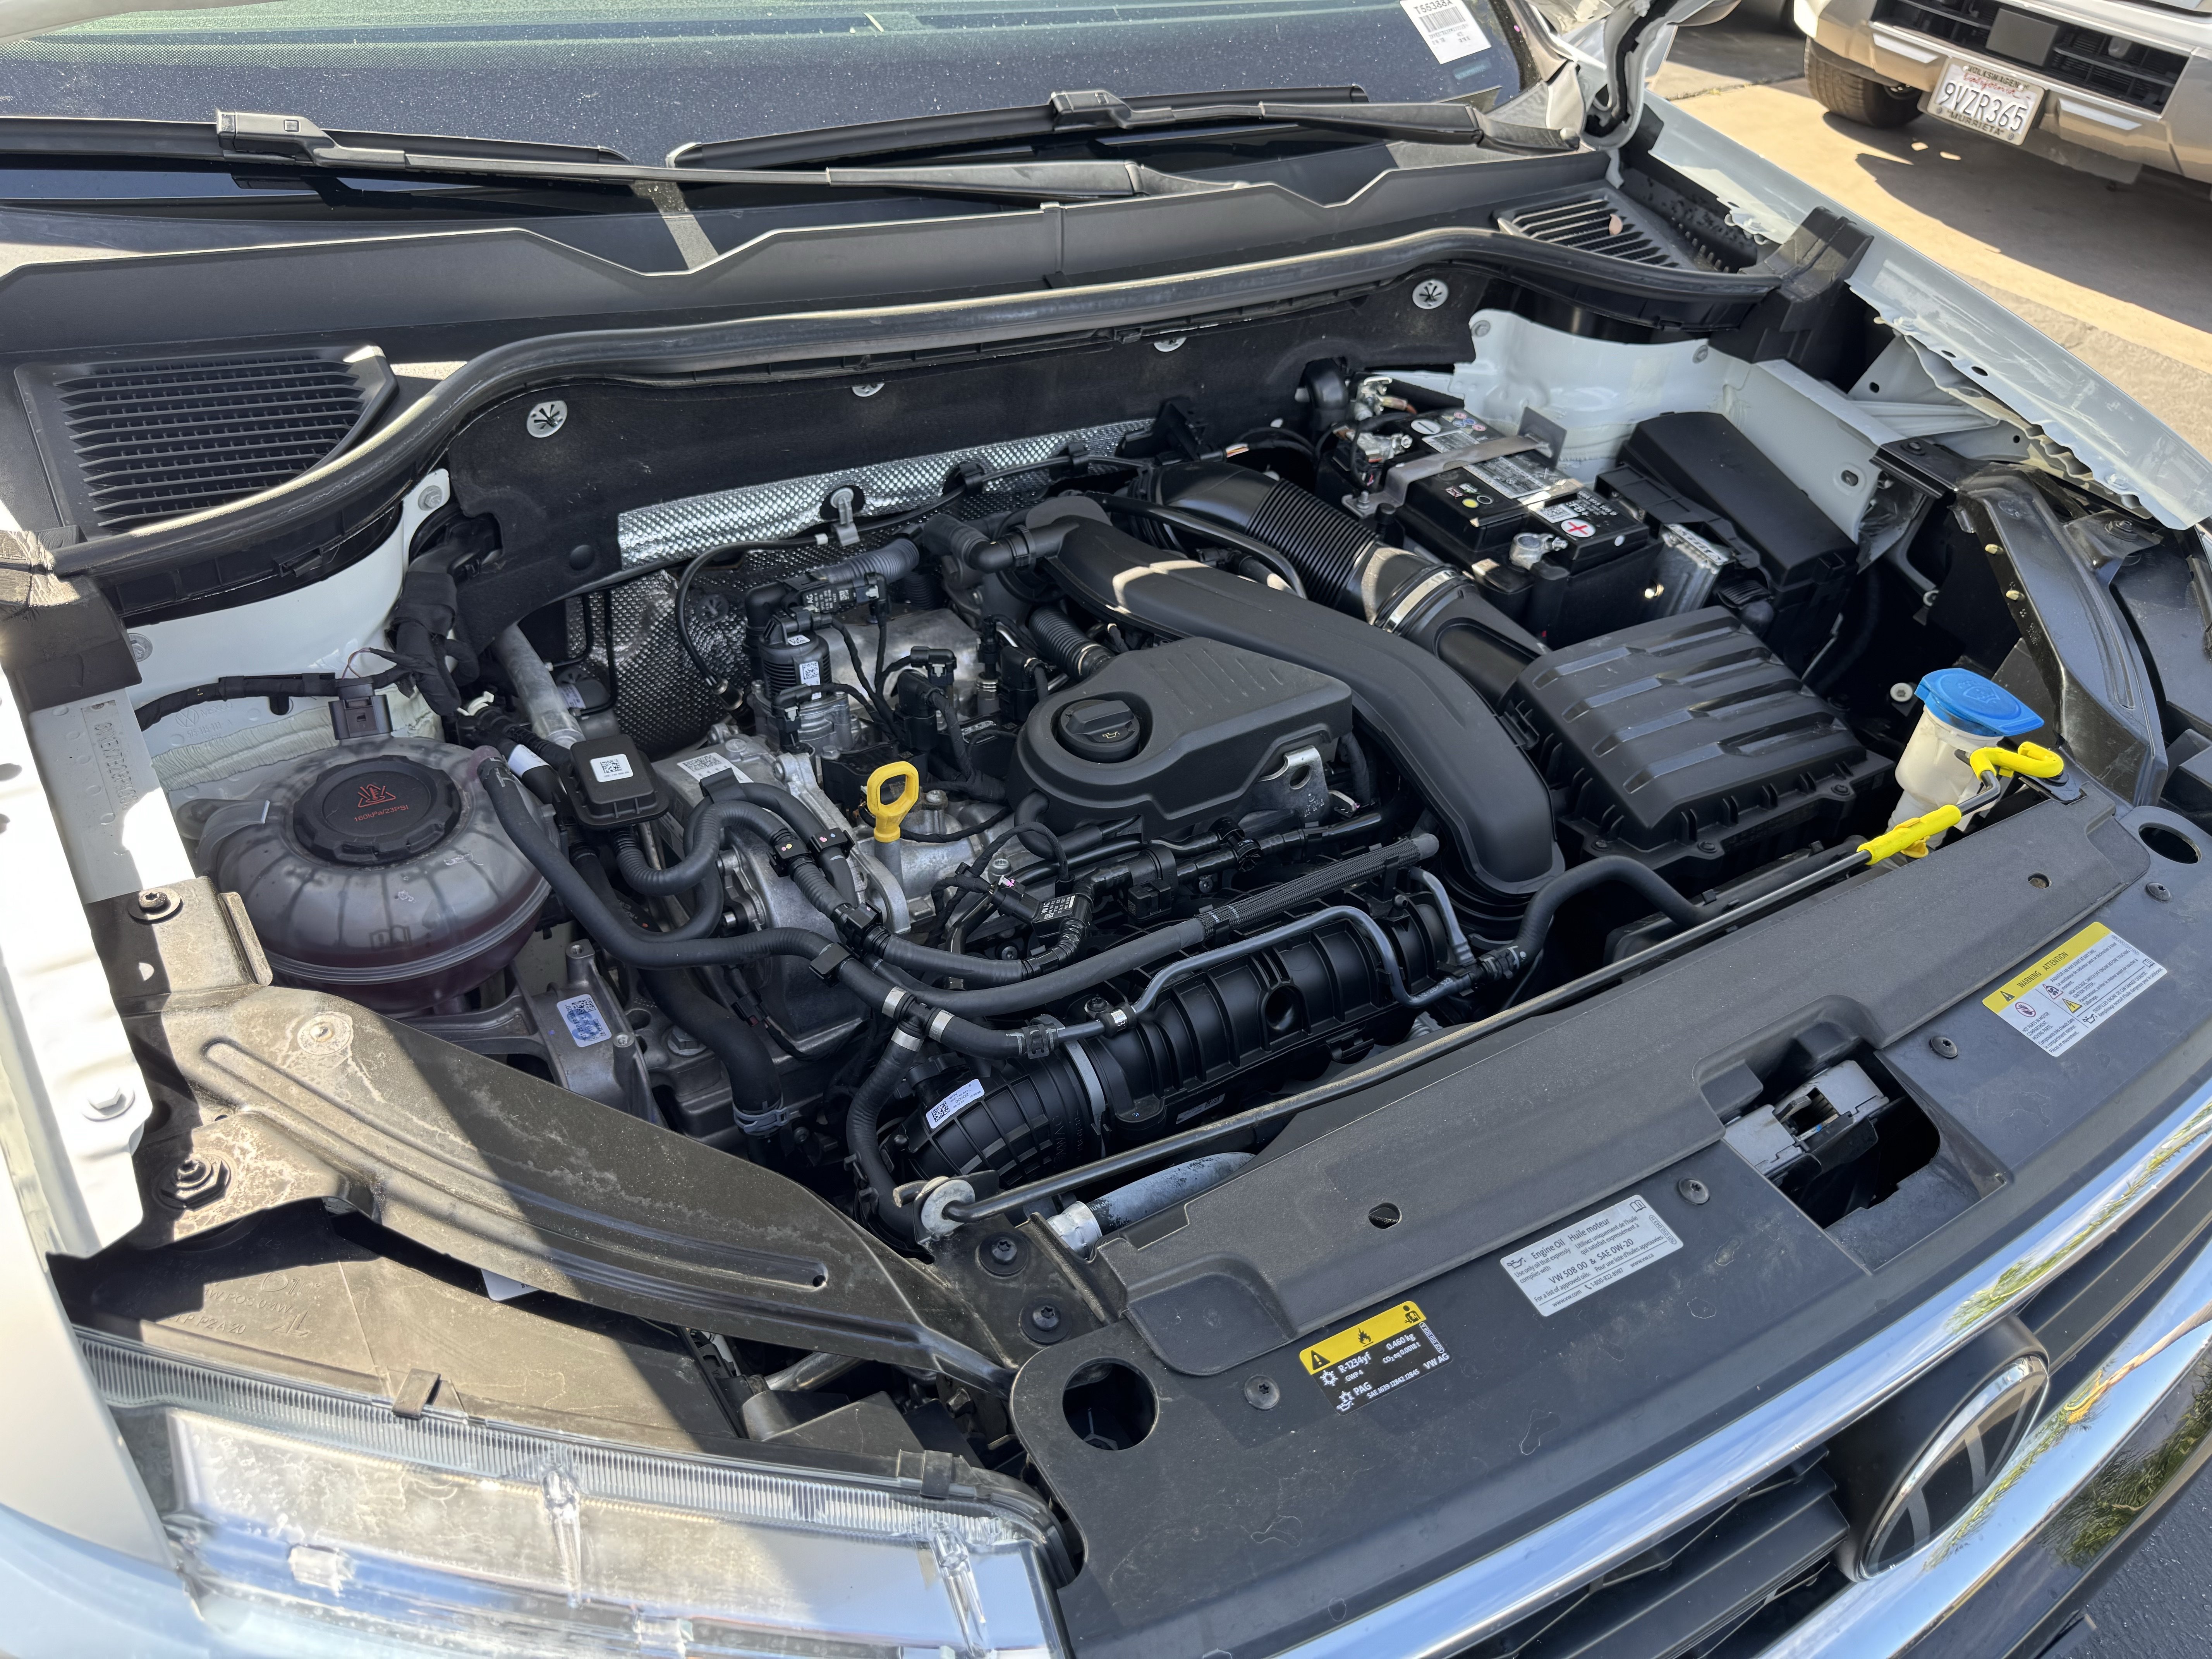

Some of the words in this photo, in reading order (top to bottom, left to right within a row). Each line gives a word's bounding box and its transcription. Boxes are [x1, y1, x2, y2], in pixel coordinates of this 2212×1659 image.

[1939, 79, 2028, 133] 9VZR365
[354, 805, 408, 822] 160kPa/23PSI
[2016, 970, 2042, 988] WARNING
[2042, 951, 2068, 971] ATTENTION
[2085, 974, 2096, 982] SWITCH
[2098, 964, 2109, 972] ENGINE
[2107, 957, 2119, 966] BEFORE
[2116, 949, 2130, 959] TOUCHING
[2107, 974, 2117, 982] moteur
[2125, 960, 2136, 968] toucher
[2092, 1000, 2109, 1013] OVERFILLED
[2106, 993, 2118, 1002] ENGINE
[2124, 979, 2136, 989] DAMAGE
[2038, 1012, 2049, 1020] MOTOR
[2032, 1030, 2044, 1040] MOVING
[2038, 1032, 2056, 1045] Composants
[2058, 1022, 2069, 1030] chauds
[1567, 1230, 1587, 1241] Huile
[1586, 1218, 1610, 1233] moteur
[1574, 1238, 1593, 1249] Utilisez
[1592, 1224, 1619, 1241] uniquement
[1623, 1216, 1638, 1225] l'huile
[1661, 1228, 1669, 1236] 010
[1580, 1247, 1592, 1255] qui
[1590, 1239, 1606, 1250] satisfait
[1606, 1224, 1636, 1242] expressément
[1530, 1245, 1555, 1259] Engine
[1554, 1238, 1565, 1248] Oil
[1549, 1248, 1571, 1260] expressly
[1594, 1264, 1606, 1272] Pour
[1623, 1247, 1640, 1258] d'huiles
[1639, 1235, 1664, 1250] approuvées:
[1548, 1273, 1563, 1283] VW
[1562, 1266, 1578, 1277] 508
[1577, 1261, 1588, 1270] 00
[1596, 1249, 1612, 1260] SAE
[1610, 1238, 1633, 1253] 0W-20
[1630, 1253, 1654, 1267] www.vw.ca
[1520, 1271, 1540, 1283] complies
[1559, 1275, 1581, 1290] approved
[1590, 1267, 1623, 1287] 1-800-822-8987
[1552, 1290, 1582, 1307] www.vw.com
[1386, 1336, 1406, 1350] 0.460
[1399, 1343, 1417, 1355] 0.0018
[1338, 1351, 1371, 1373] R-1234yf
[1423, 1358, 1437, 1369] VW
[1437, 1353, 1449, 1363] AG
[1345, 1371, 1358, 1381] GWP
[1353, 1381, 1372, 1395] PAG
[1367, 1389, 1379, 1399] SAE
